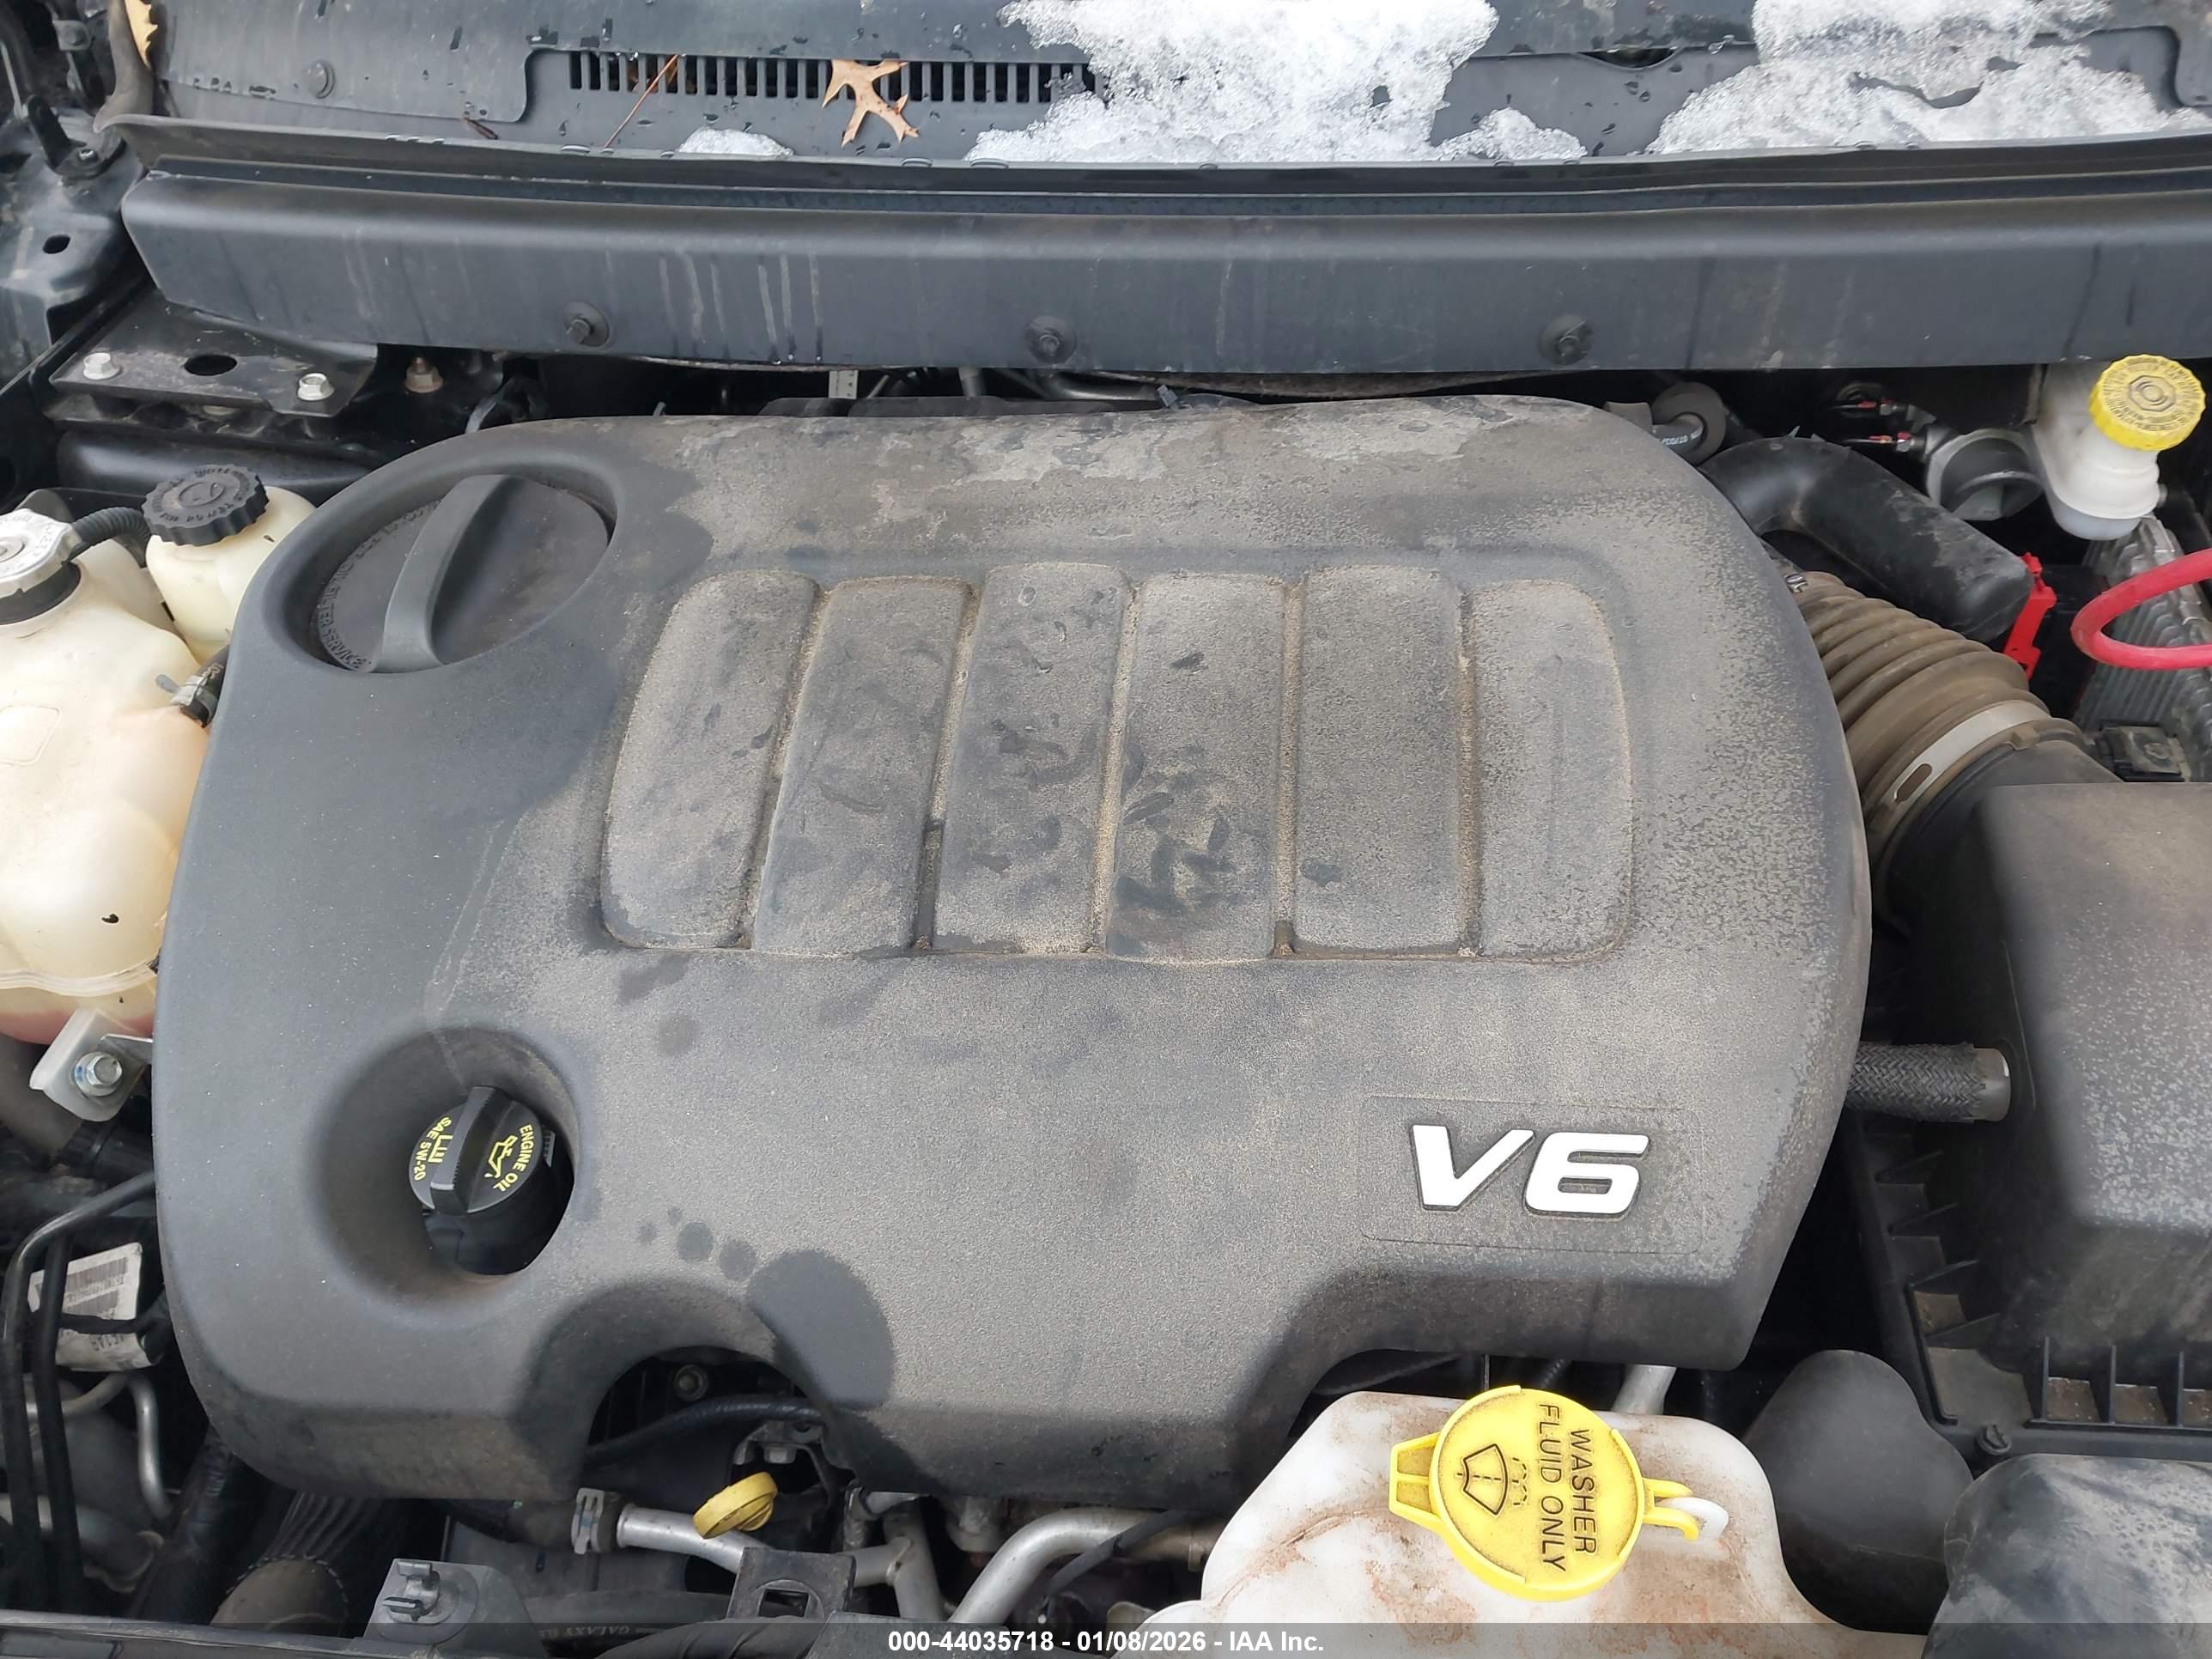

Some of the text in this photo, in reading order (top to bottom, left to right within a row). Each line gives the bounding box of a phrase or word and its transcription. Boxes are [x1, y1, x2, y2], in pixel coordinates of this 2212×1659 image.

[414, 1116, 452, 1181] SAE 5W-20
[493, 1124, 535, 1192] ENGINE OIL
[1409, 1124, 1650, 1218] V6
[1539, 1404, 1567, 1572] FLUID ONLY
[1570, 1429, 1597, 1554] WASHER
[563, 1626, 630, 1636] GALAXY
